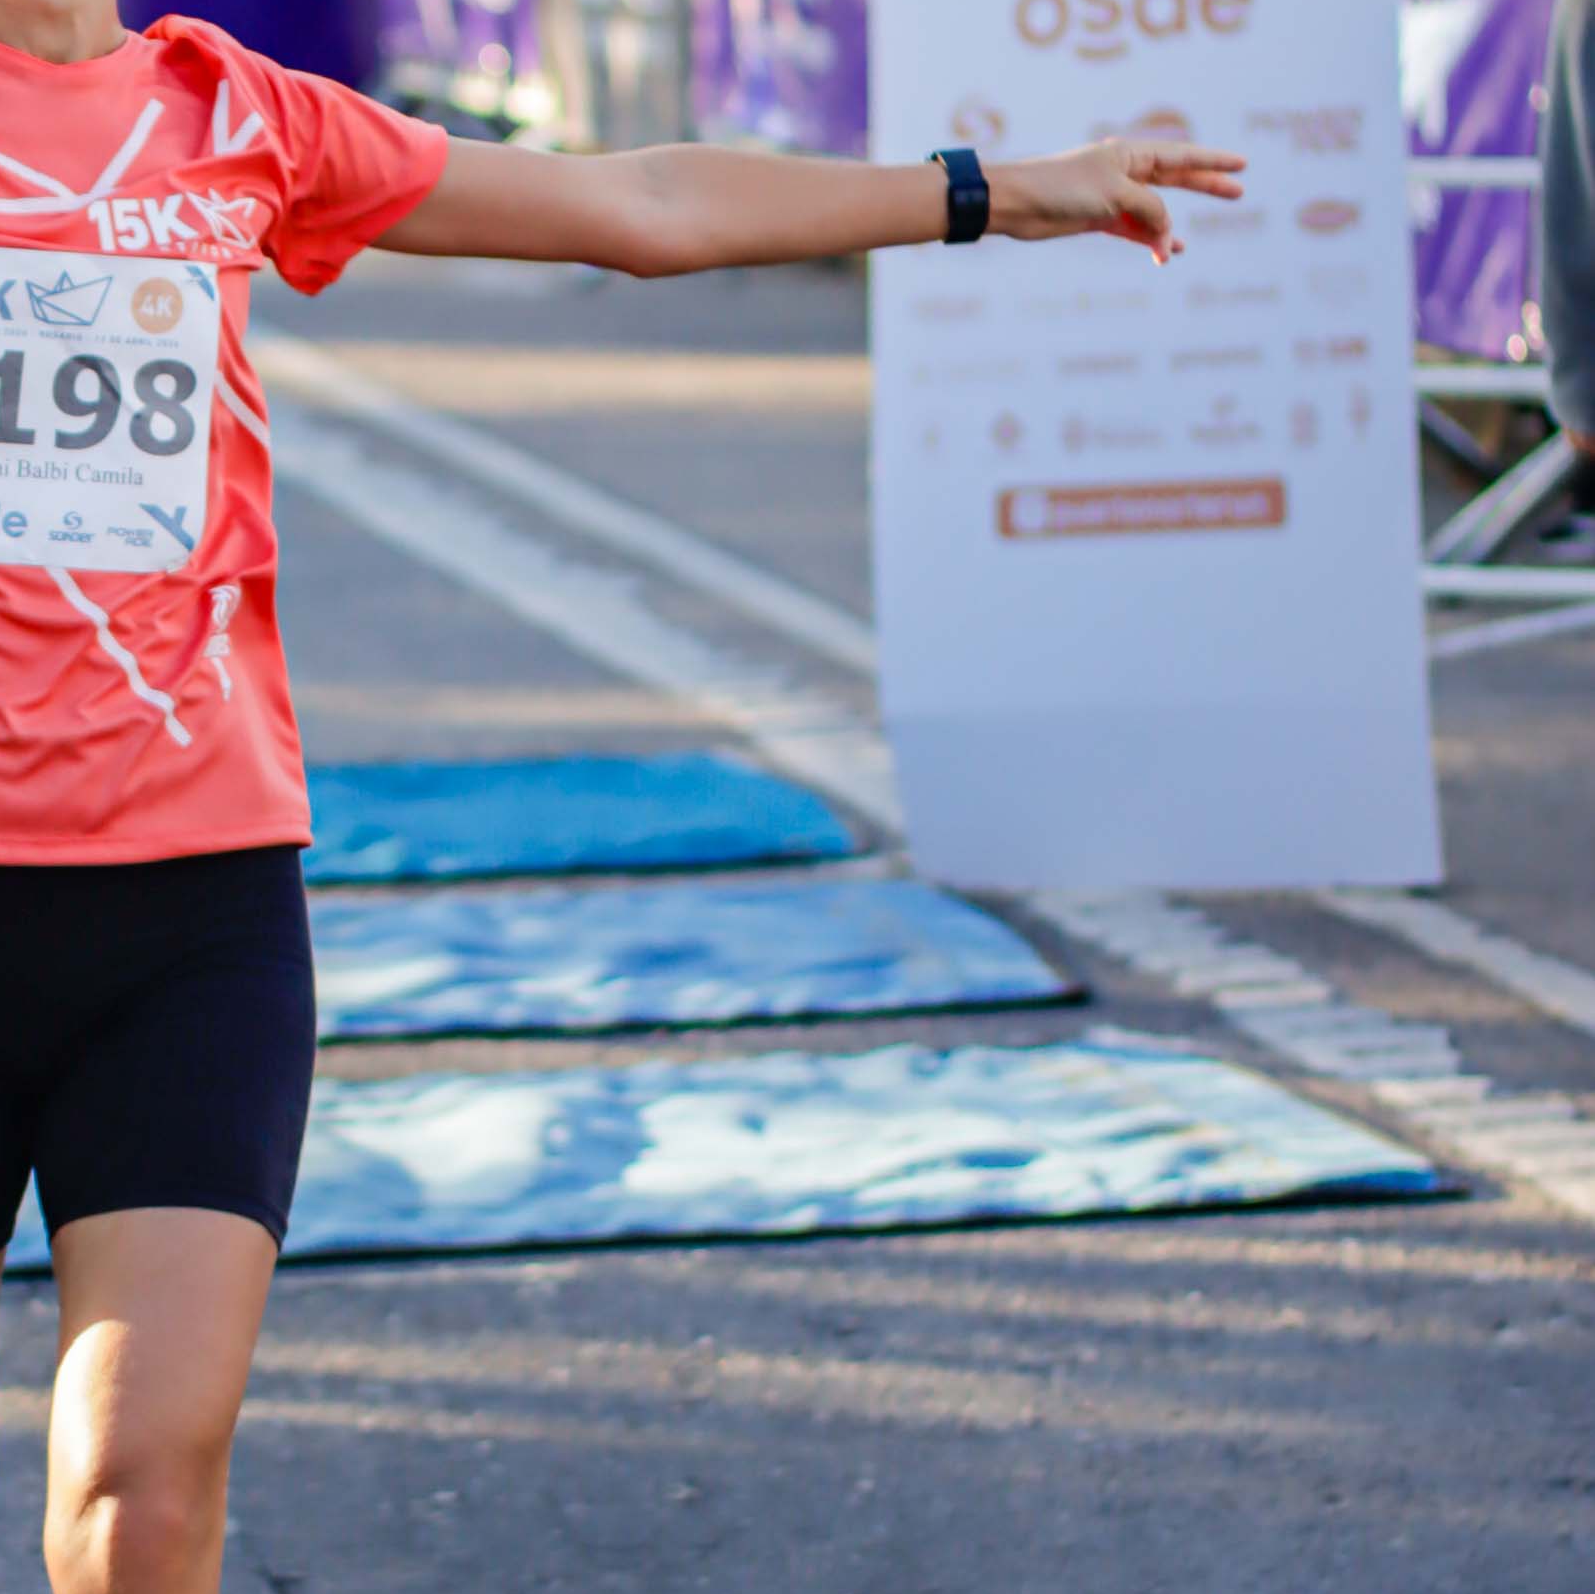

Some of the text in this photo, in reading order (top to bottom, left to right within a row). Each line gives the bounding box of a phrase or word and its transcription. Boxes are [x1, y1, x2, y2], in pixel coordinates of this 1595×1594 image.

[87, 192, 199, 252] 15K
[139, 293, 174, 319] 4K
[16, 456, 68, 481] Balbi
[75, 463, 144, 486] Camila
